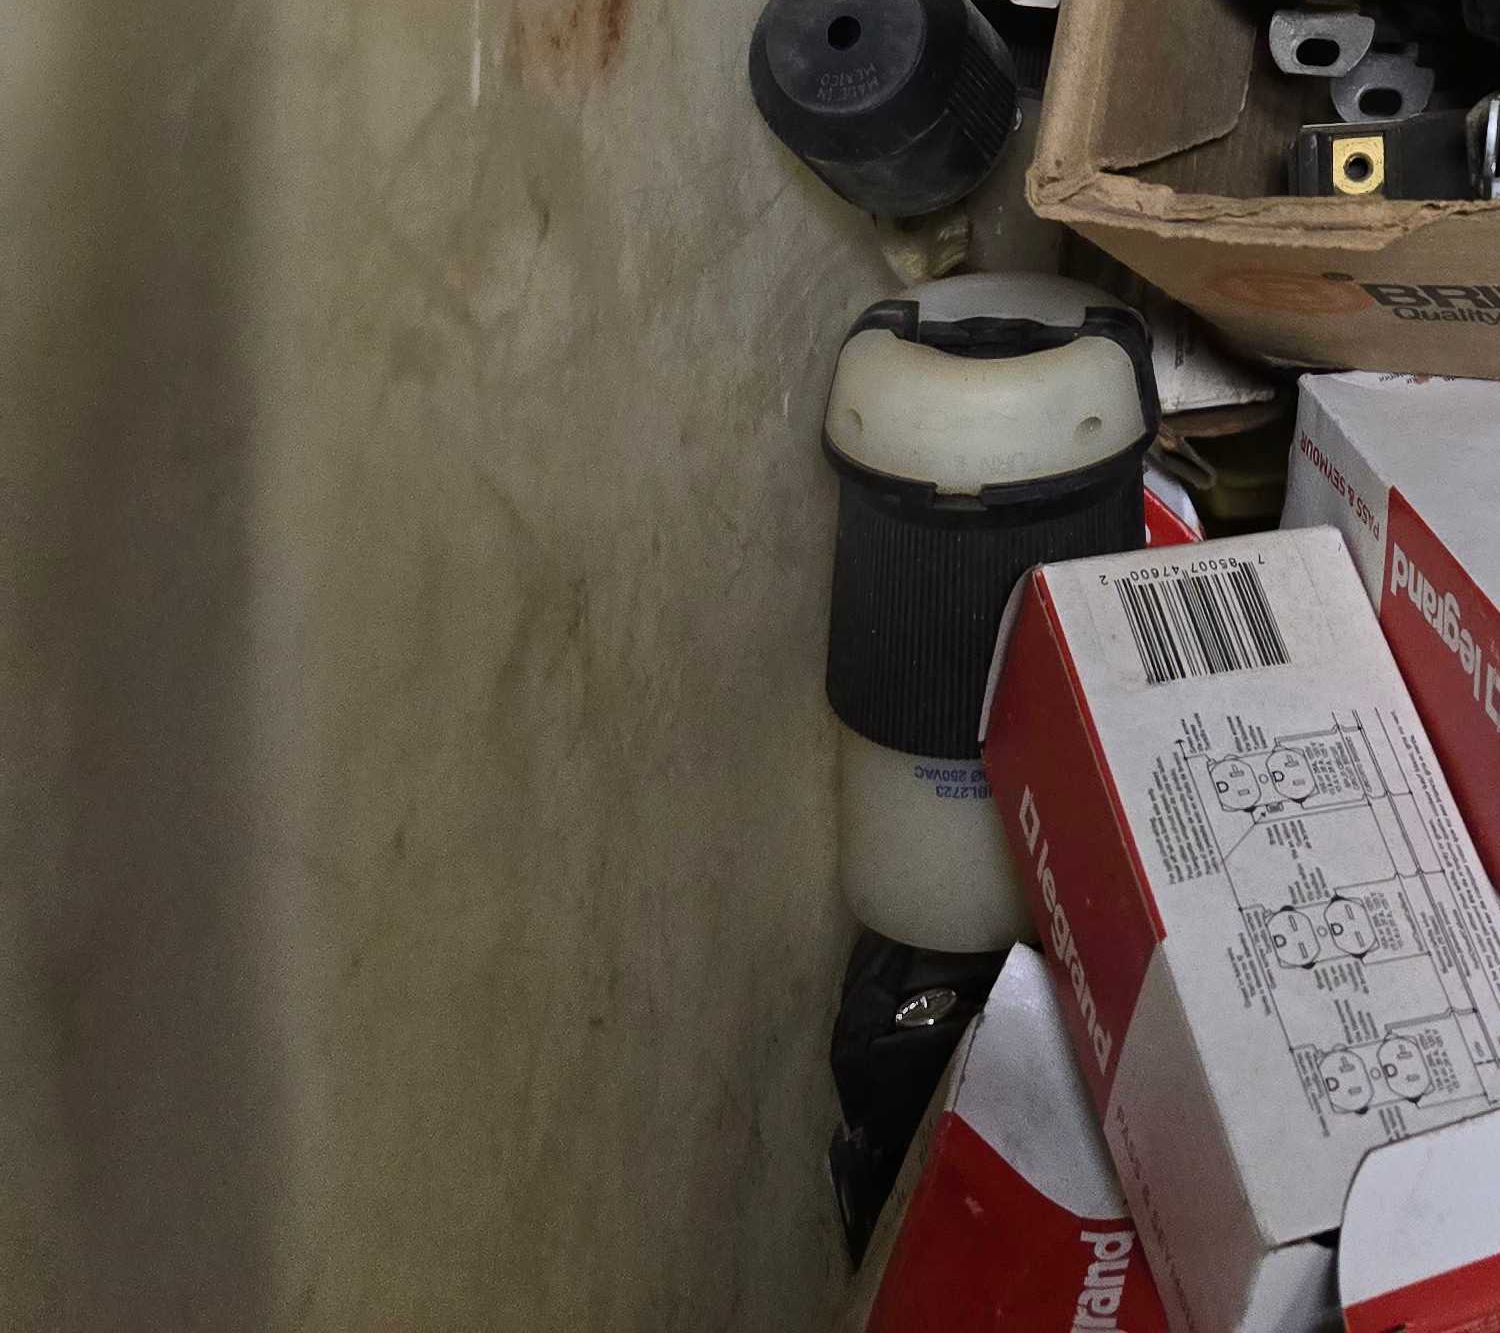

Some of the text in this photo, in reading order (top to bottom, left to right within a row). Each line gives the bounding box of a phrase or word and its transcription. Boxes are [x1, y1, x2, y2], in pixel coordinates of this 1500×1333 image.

[1189, 555, 1237, 573] 85007
[1256, 552, 1265, 564] 7
[1098, 573, 1108, 586] 2
[1390, 542, 1482, 702] legrand
[1035, 838, 1114, 1076] legrand
